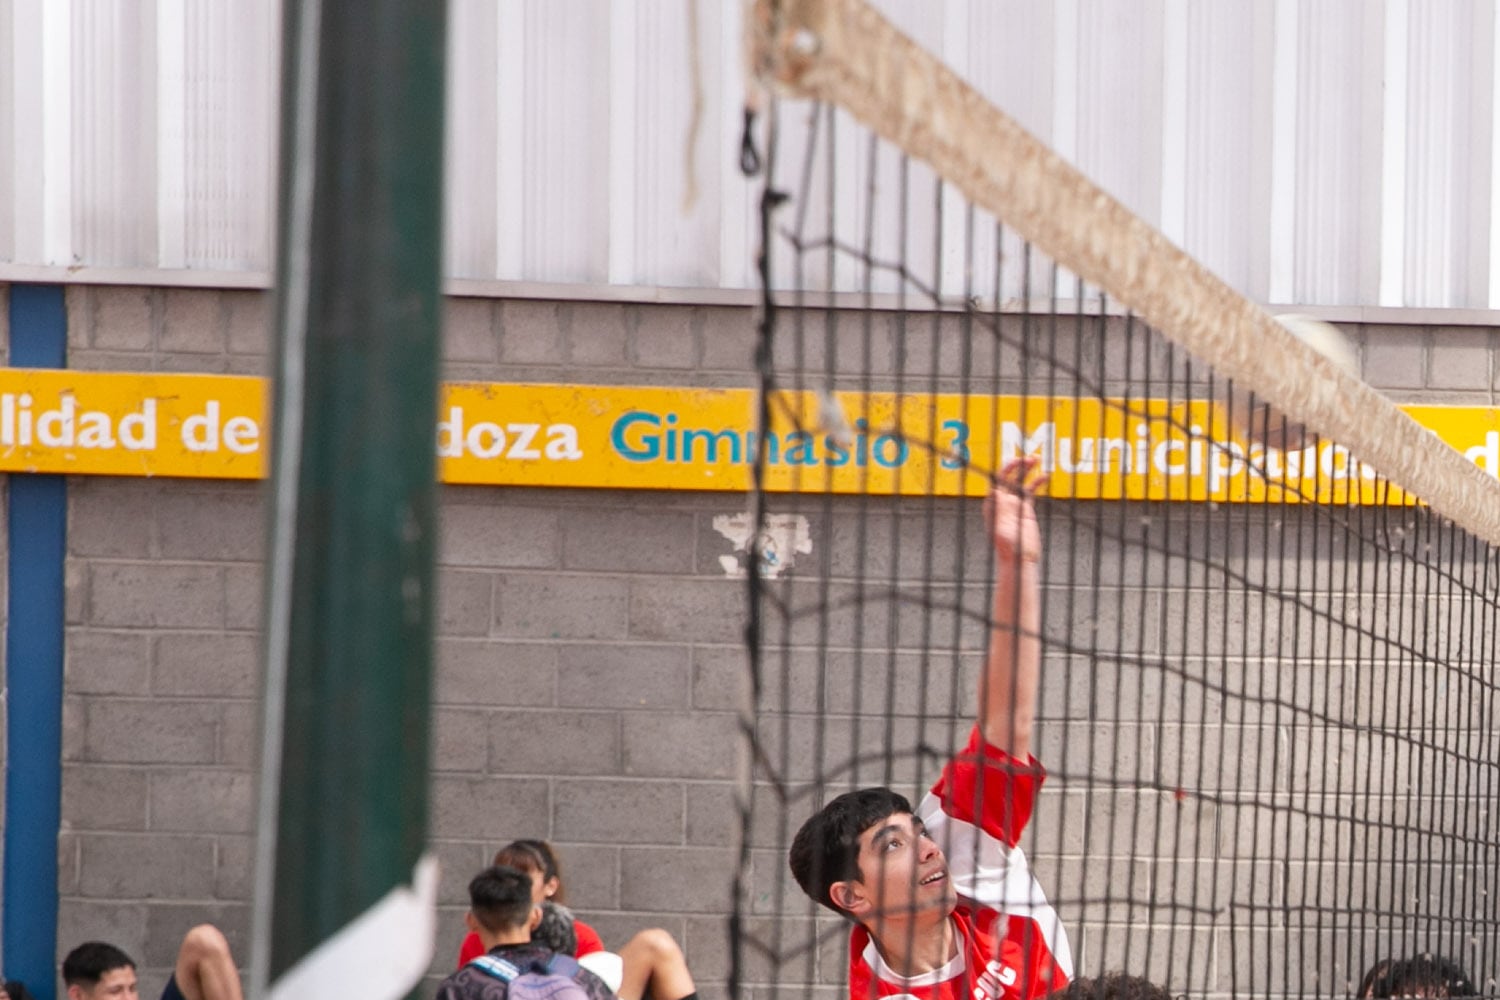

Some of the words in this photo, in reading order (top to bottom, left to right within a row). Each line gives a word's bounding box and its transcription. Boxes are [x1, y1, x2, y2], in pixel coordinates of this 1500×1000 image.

[0, 393, 156, 450] lidad
[181, 400, 260, 453] de
[611, 411, 909, 468] Gimnasio
[941, 419, 970, 469] 3
[999, 421, 1437, 493] Municipalid
